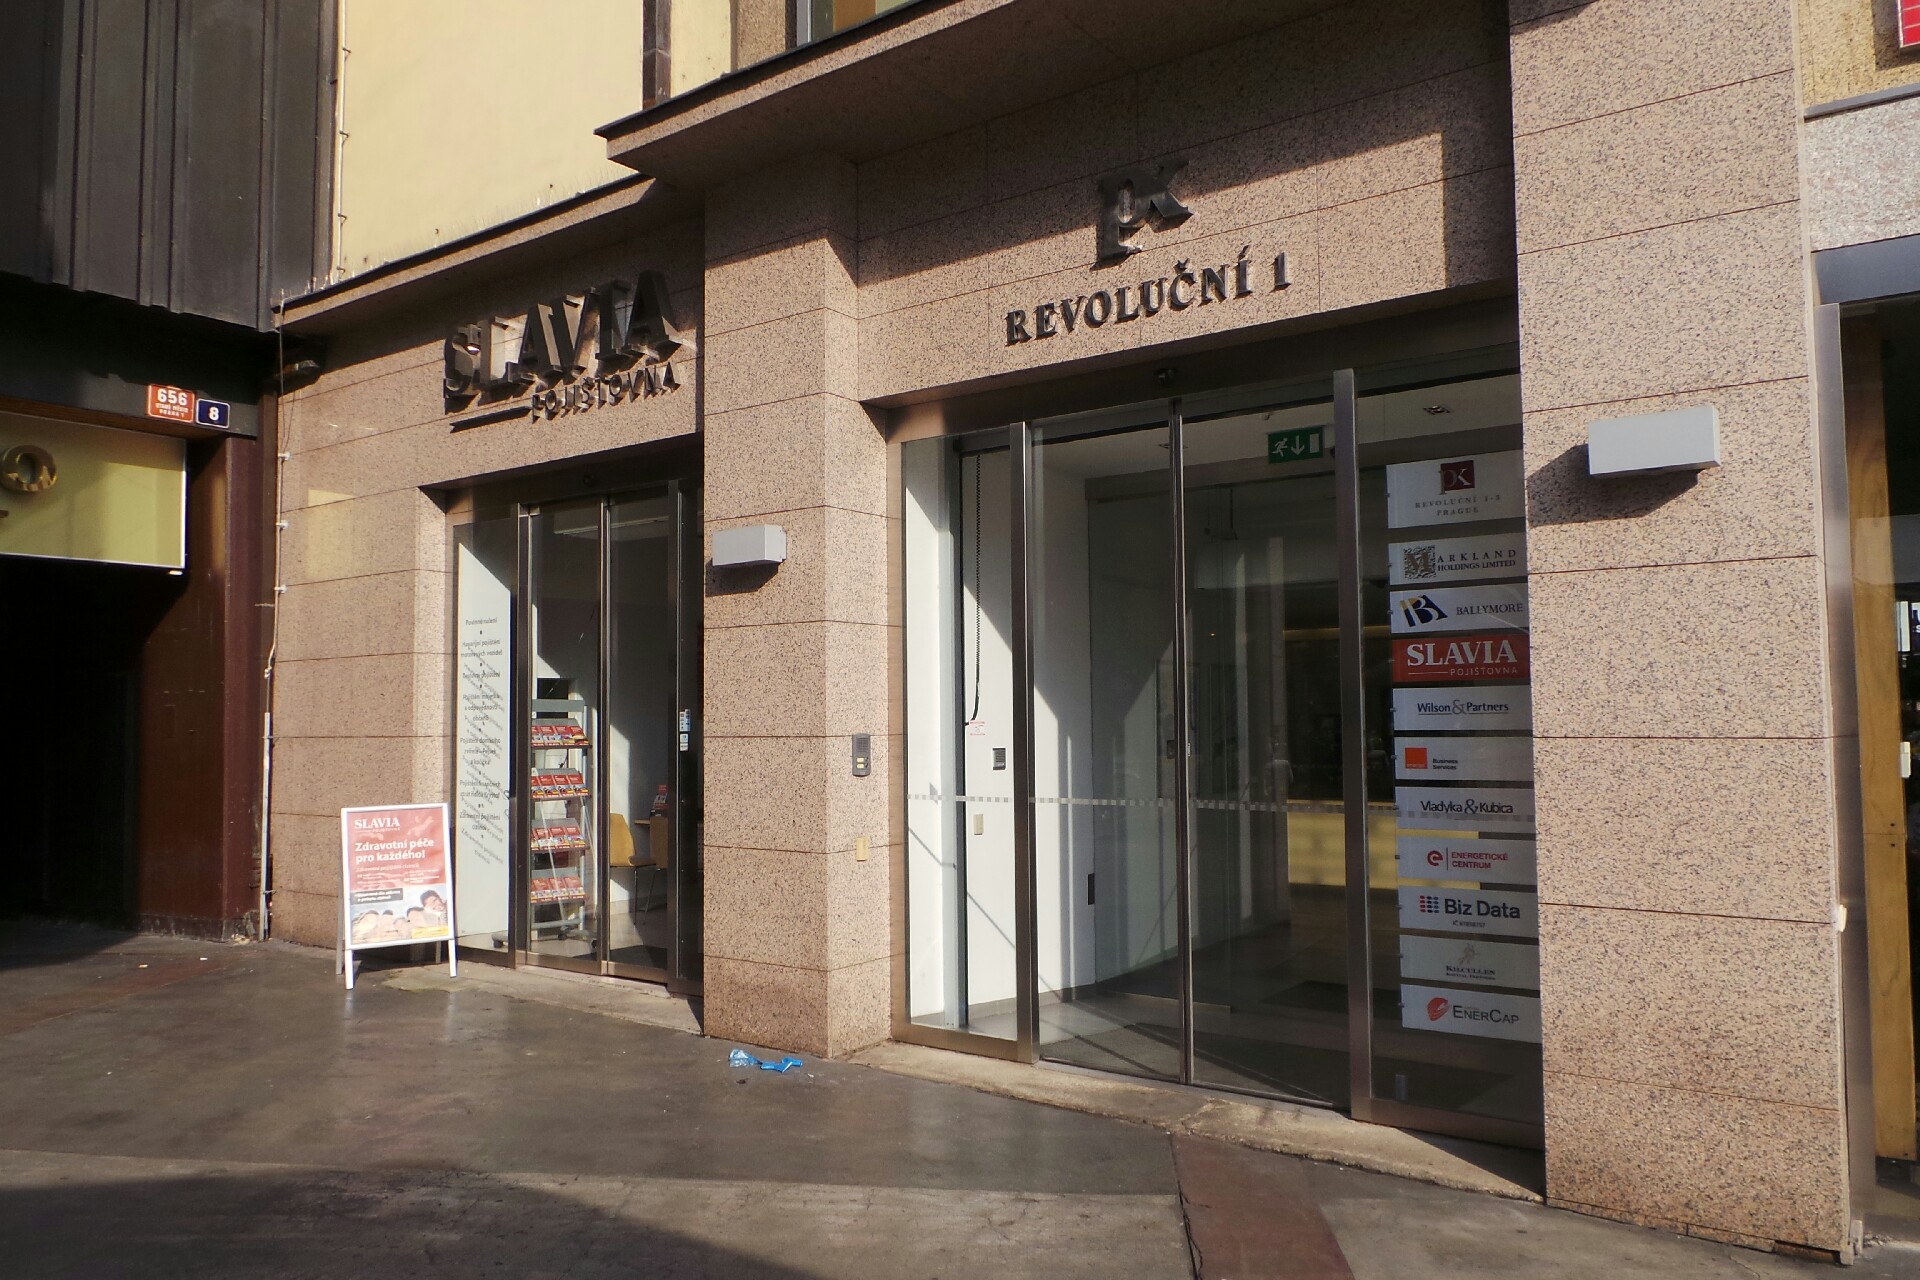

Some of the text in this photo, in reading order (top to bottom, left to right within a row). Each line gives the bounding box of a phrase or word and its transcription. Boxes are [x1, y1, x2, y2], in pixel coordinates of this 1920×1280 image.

[1004, 246, 1291, 344] REVOLUČNÍ 1
[444, 269, 682, 396] SLAVIA
[157, 388, 188, 406] 656
[208, 406, 220, 421] 8
[1436, 506, 1479, 517] PRAGUE
[1437, 559, 1516, 572] HOLDINGS LIMITED
[1455, 602, 1524, 616] BALLYMORE
[1407, 639, 1518, 667] SLAVIA
[1417, 702, 1451, 713] Wilson
[1466, 701, 1509, 713] Partners
[1420, 800, 1463, 813] Vladyka
[1479, 802, 1514, 814] Kubica
[354, 817, 401, 829] SLAVIA
[354, 837, 435, 852] Zdravotní péče
[355, 849, 426, 865] pro každého!
[1451, 851, 1509, 861] ENERGETICKÉ
[1452, 861, 1492, 869] CENTRUM
[1444, 898, 1521, 919] Biz Data
